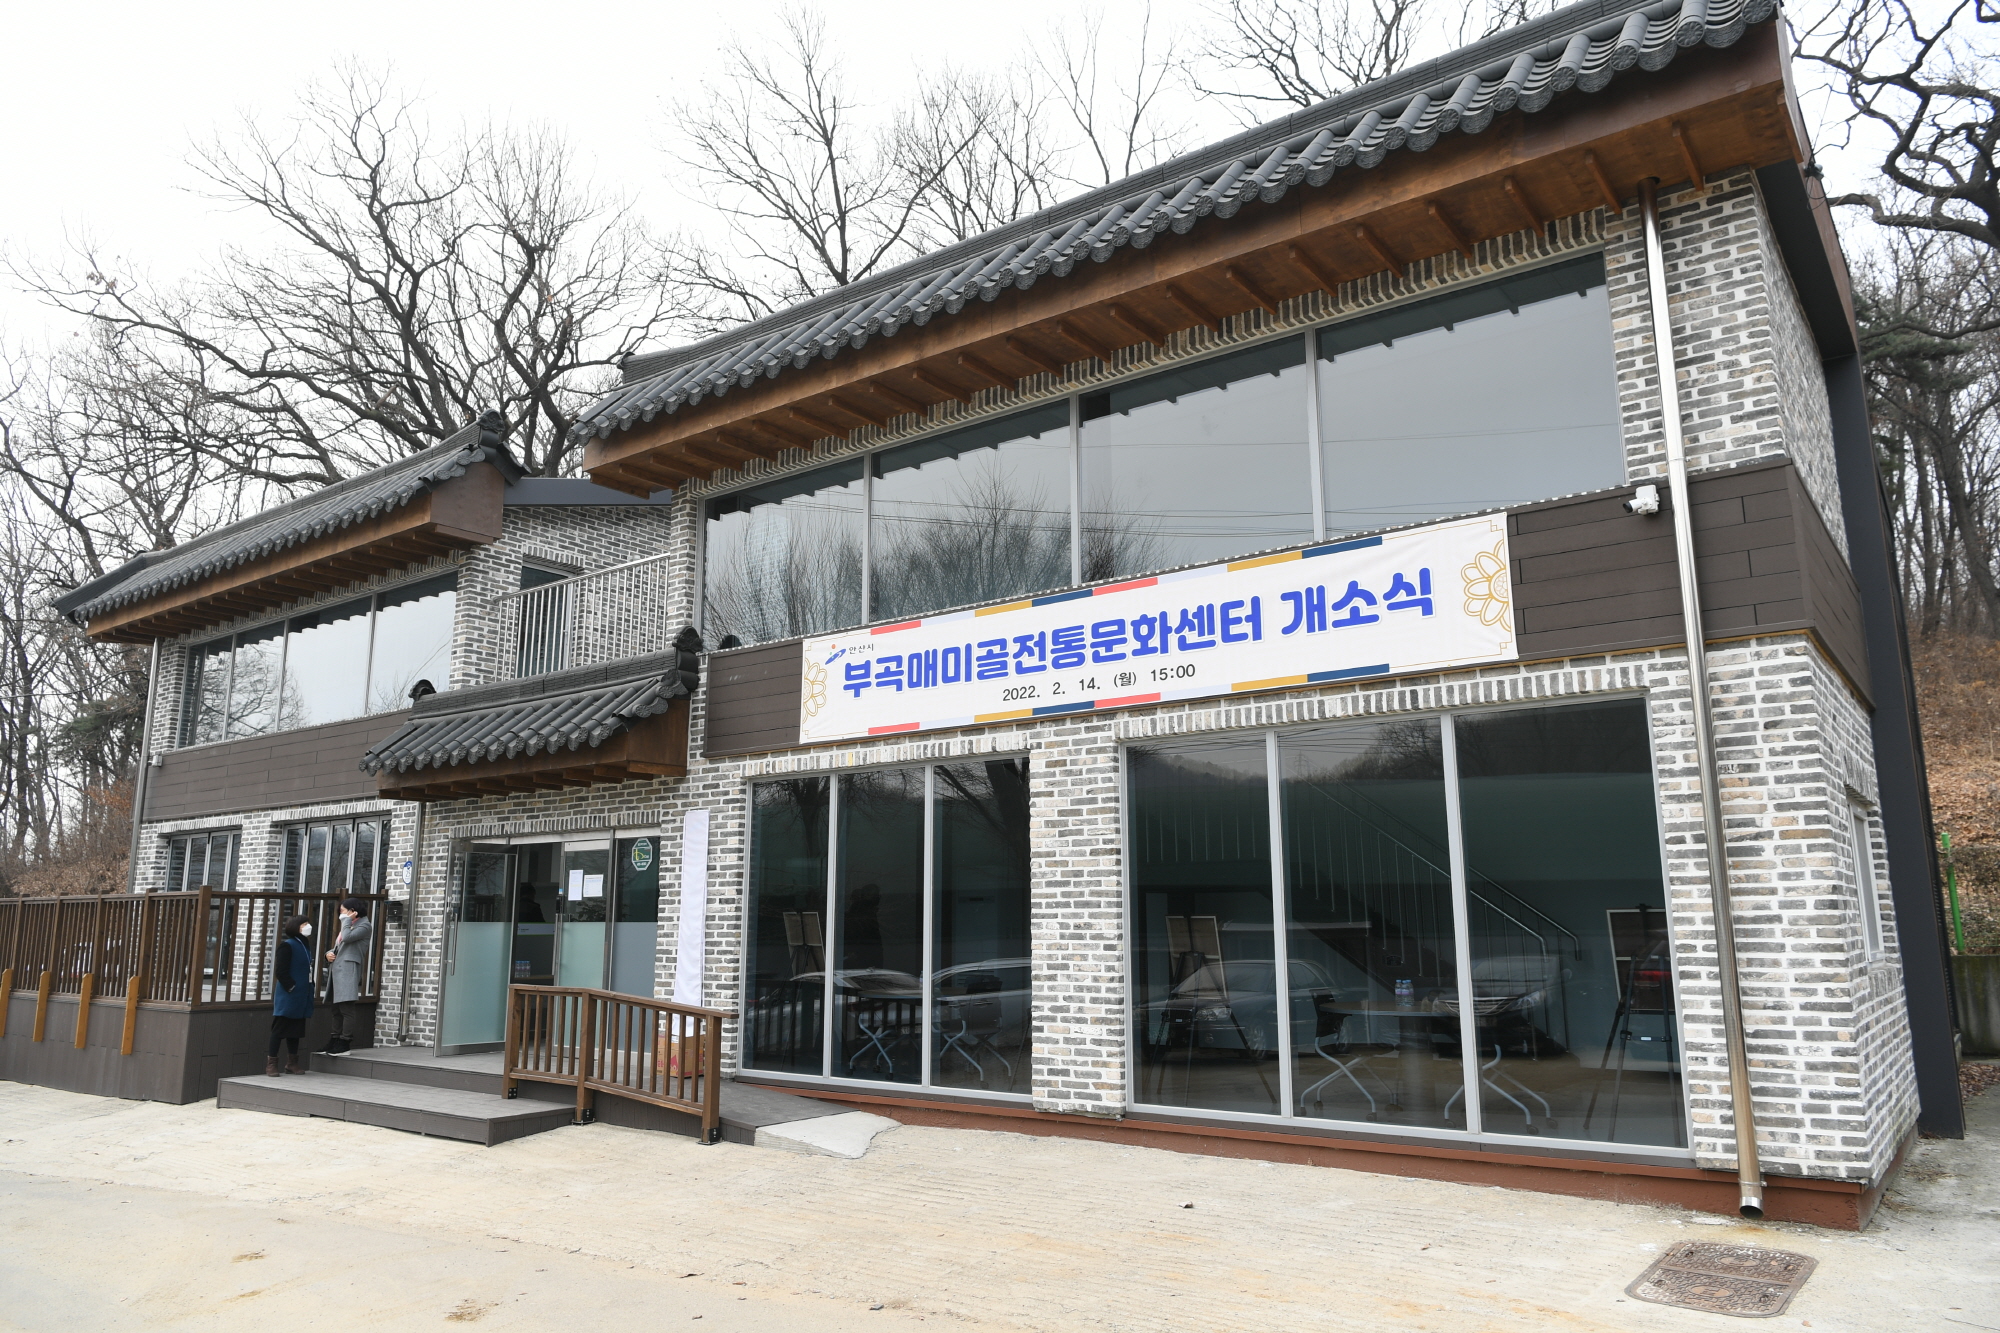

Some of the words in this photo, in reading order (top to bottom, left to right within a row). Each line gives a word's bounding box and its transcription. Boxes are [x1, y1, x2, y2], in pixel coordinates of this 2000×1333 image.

[843, 595, 1263, 698] 부곡매미골전통문화센터
[1280, 567, 1434, 636] 개소식
[848, 643, 874, 655] 안산시
[1002, 685, 1041, 702] 2022.
[1052, 681, 1066, 695] 2.
[1078, 677, 1101, 692] 14.
[1113, 671, 1137, 687] (월)
[1150, 664, 1196, 682] 15:00
